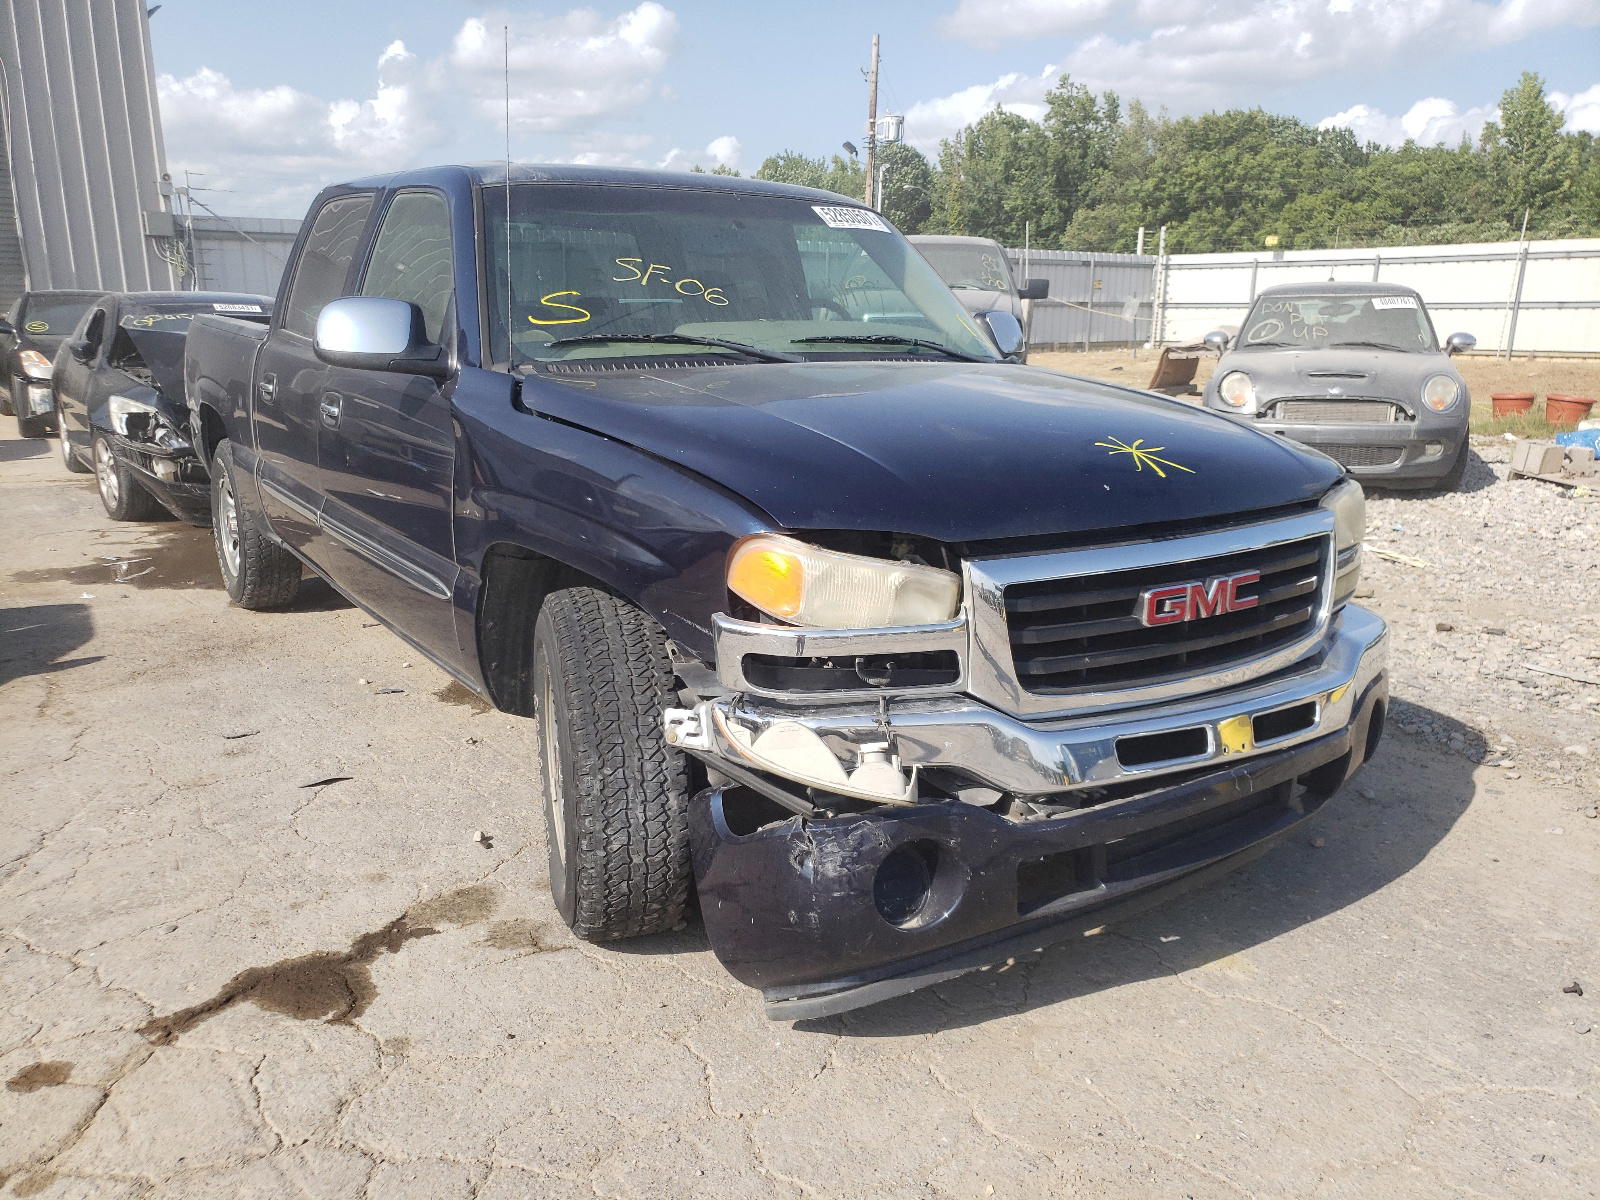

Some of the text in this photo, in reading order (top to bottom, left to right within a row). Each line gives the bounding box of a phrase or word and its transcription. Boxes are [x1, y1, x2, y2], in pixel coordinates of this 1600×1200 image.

[612, 257, 729, 306] SF-06
[527, 290, 591, 325] S
[1139, 569, 1261, 628] GMC
